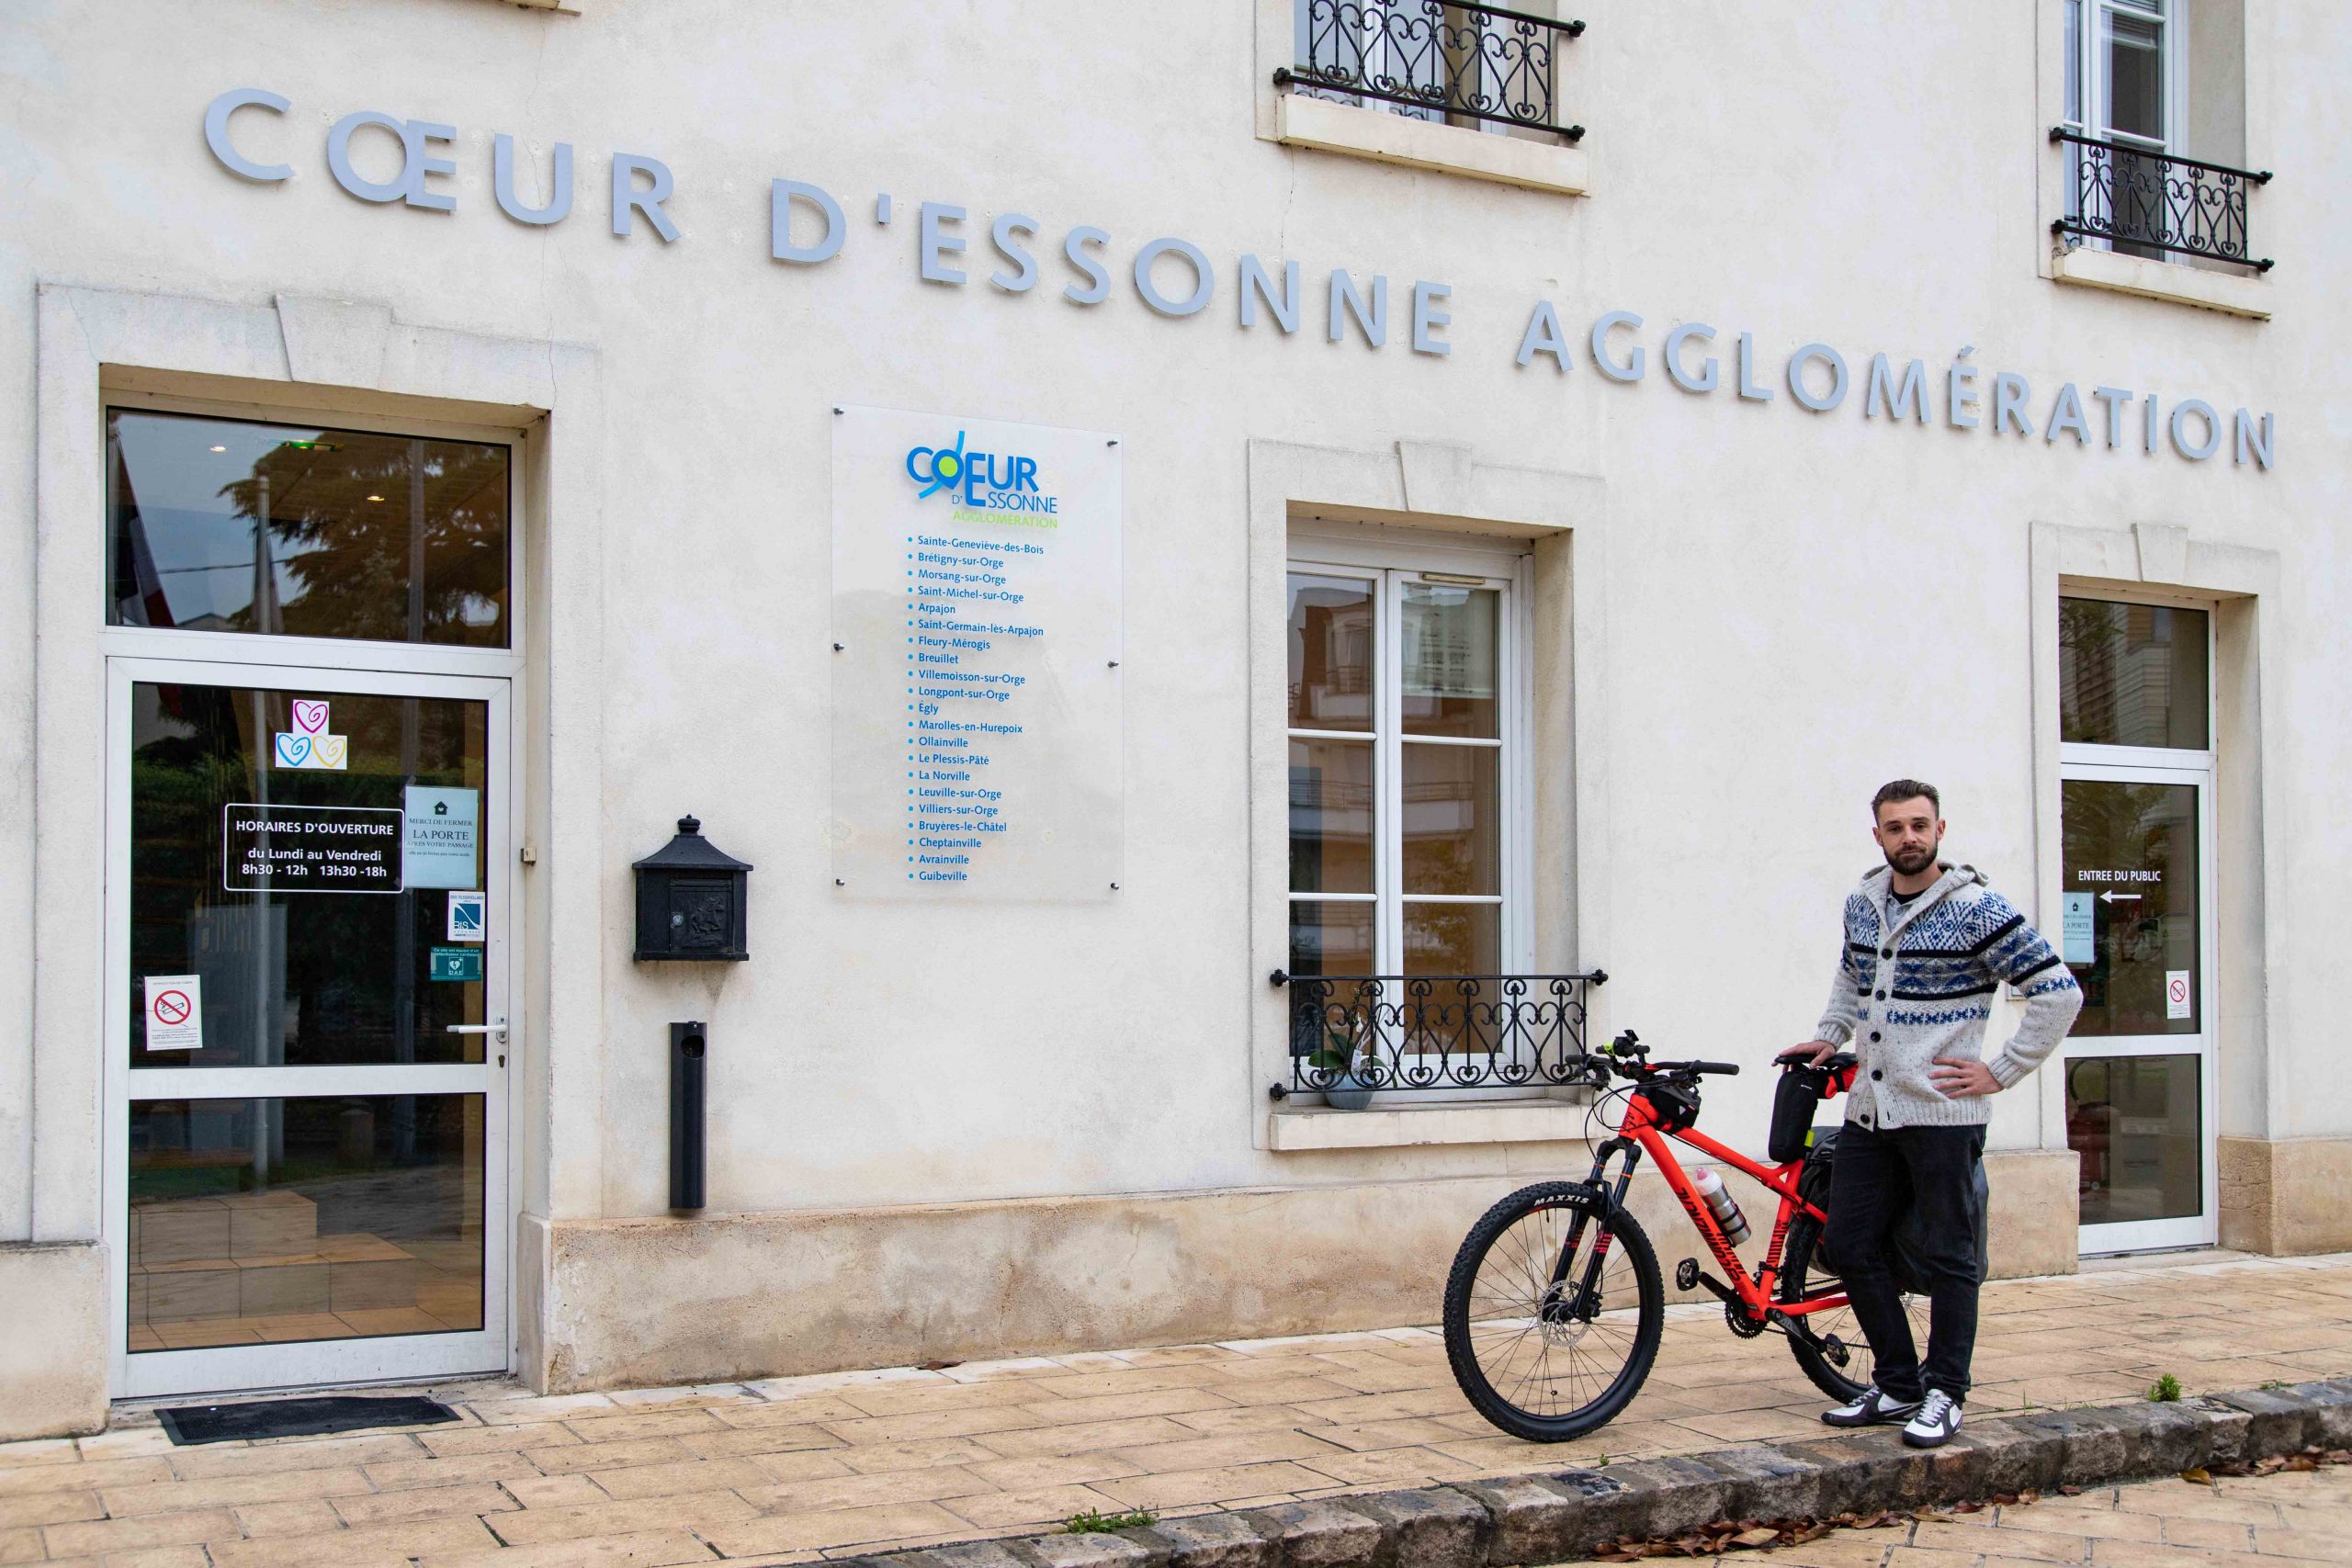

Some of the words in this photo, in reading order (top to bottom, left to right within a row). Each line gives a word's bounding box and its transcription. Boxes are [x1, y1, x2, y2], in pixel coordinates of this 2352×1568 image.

[772, 177, 1453, 356] D'ESSONNE
[1516, 299, 2276, 470] AGGLOMÉRATION
[918, 535, 1044, 555] Sainte-Geneviève-des-Bois
[918, 551, 1004, 570] Brétigny-sur-Orge
[918, 569, 1006, 586] Morsang-sur-Orge
[918, 585, 1024, 604] Saint-Michel-sur-Orge
[918, 603, 956, 615] Arpajon
[918, 618, 1044, 637] Saint-Germain-lès-Arpajon
[918, 636, 990, 651] Fleury-Mérogis
[918, 652, 959, 664] Breuillet
[919, 670, 1025, 686] Villemoisson-sur-Orge
[919, 686, 1011, 702] Longpont-sur-Orge
[919, 700, 939, 716] Égly
[919, 719, 1023, 735] Marolles-en-Hurepoix
[919, 736, 968, 748] Ollainville
[919, 753, 930, 763] Le
[933, 753, 989, 765] Plessis-Pâté
[919, 771, 930, 780] La
[933, 771, 970, 781] Norville
[919, 787, 1001, 801] Leuville-sur-Orge
[919, 804, 999, 818] Villiers-sur-Orge
[236, 820, 301, 833] HORAIRES
[305, 822, 394, 836] D'OUVERTURE
[919, 820, 1007, 832] Bruyères-le-Châtel
[413, 829, 428, 839] LA
[431, 829, 469, 840] PORTE
[919, 837, 982, 850] Cheptainville
[248, 848, 265, 859] du
[268, 848, 303, 860] Lundi
[307, 851, 322, 860] au
[326, 849, 381, 862] Vendredi
[919, 854, 969, 865] Avrainville
[242, 863, 273, 875] 8h30
[286, 864, 308, 875] 12h
[320, 865, 356, 877] 13h30
[919, 871, 967, 881] Guibeville
[2078, 870, 2112, 881] ENTREE
[2114, 870, 2128, 882] DU
[2130, 870, 2161, 882] PUBLIC
[1533, 1194, 1589, 1206] MAXXIS
